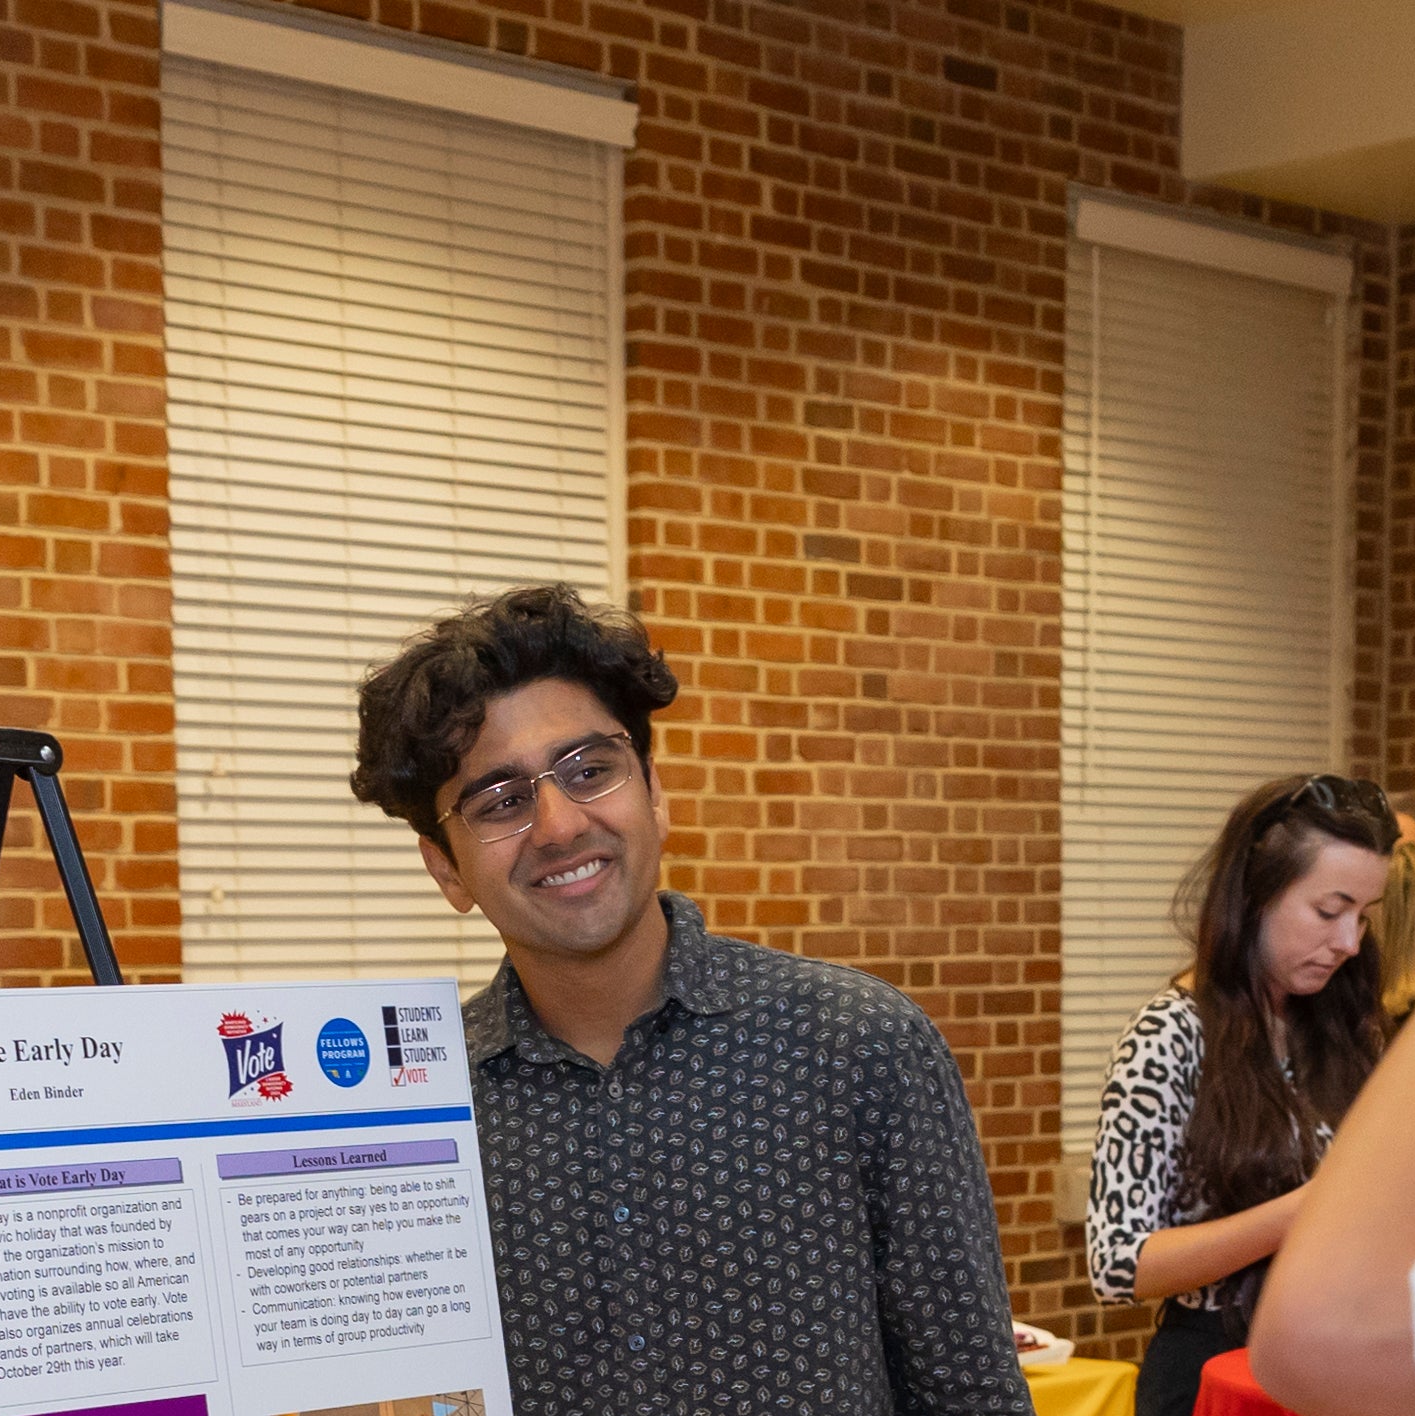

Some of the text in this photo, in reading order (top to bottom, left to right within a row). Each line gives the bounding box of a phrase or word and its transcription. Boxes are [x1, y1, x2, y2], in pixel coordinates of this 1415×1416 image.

[398, 1006, 443, 1023] STUDENTS
[320, 1037, 365, 1048] FELLOWS
[400, 1027, 429, 1043] LEARN
[12, 1037, 73, 1067] Early
[80, 1036, 123, 1064] Day
[321, 1049, 366, 1060] PROGRAM
[404, 1046, 448, 1063] STUDENTS
[236, 1039, 275, 1085] Vote
[405, 1067, 429, 1083] VOTE
[9, 1085, 85, 1101] Eden Binder
[292, 1148, 388, 1169] Lessons Learned
[14, 1172, 27, 1189] is
[28, 1172, 58, 1187] Vote
[60, 1169, 97, 1188] Early
[99, 1167, 126, 1185] Day
[12, 1209, 23, 1223] is
[25, 1211, 34, 1222] a
[36, 1204, 88, 1222] nonprofit
[89, 1199, 159, 1219] organization
[160, 1197, 183, 1211] and
[248, 1269, 429, 1297] with coworkers or potential partners
[251, 1283, 466, 1316] Communication: knowing how everyone on
[25, 1321, 83, 1340] organizes
[85, 1315, 124, 1332] annual
[126, 1310, 194, 1327] celebrations
[45, 1359, 72, 1375] 29th
[73, 1358, 96, 1371] this
[96, 1355, 126, 1372] year.
